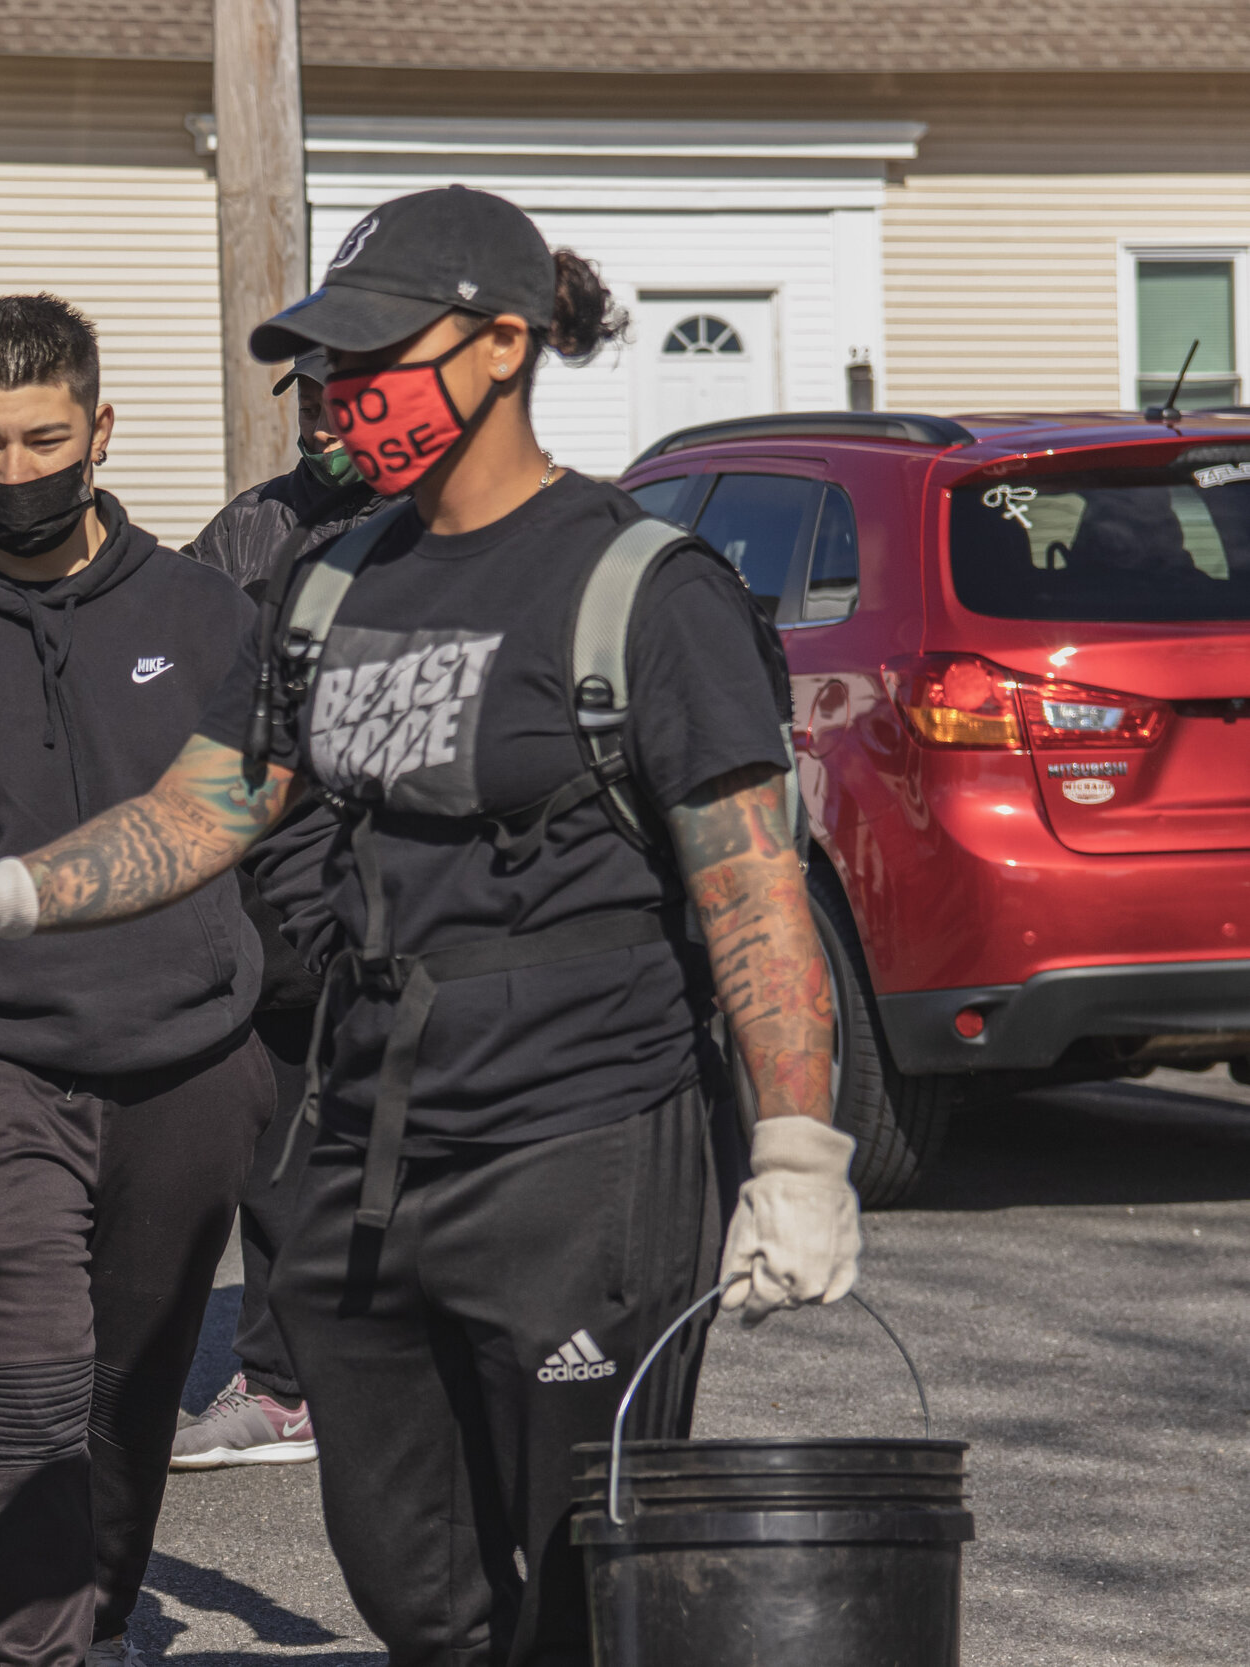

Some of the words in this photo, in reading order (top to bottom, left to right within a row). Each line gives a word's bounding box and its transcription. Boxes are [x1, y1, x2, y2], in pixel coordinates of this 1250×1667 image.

[137, 656, 166, 673] NIKE
[311, 633, 505, 735] BEAST
[310, 699, 464, 800] MODE
[1047, 761, 1129, 778] MITSUBISHI
[536, 1360, 617, 1383] adidas
